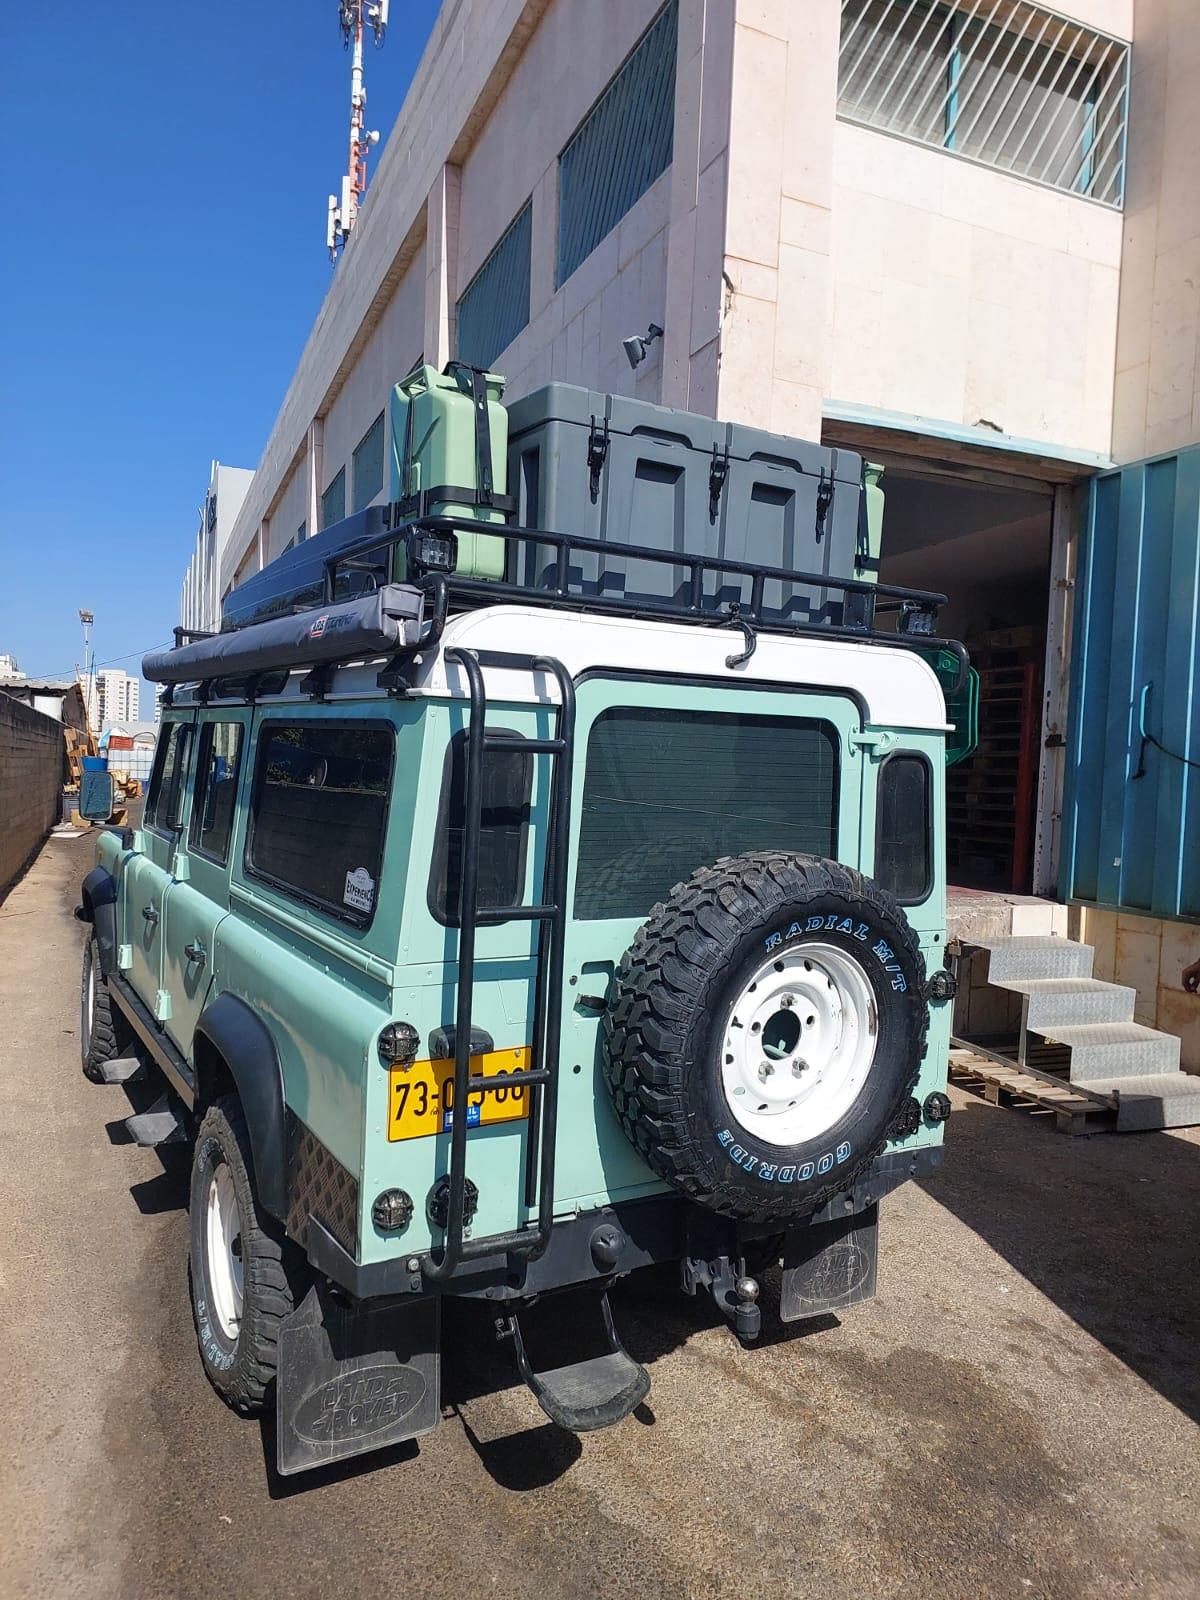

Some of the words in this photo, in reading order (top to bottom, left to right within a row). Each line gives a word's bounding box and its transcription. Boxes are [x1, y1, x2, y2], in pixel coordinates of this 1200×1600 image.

[346, 880, 375, 902] EXPERIENCE
[765, 915, 870, 952] RADIAL
[717, 1129, 851, 1183] GOODRIDE
[325, 1390, 410, 1434] ROVER
